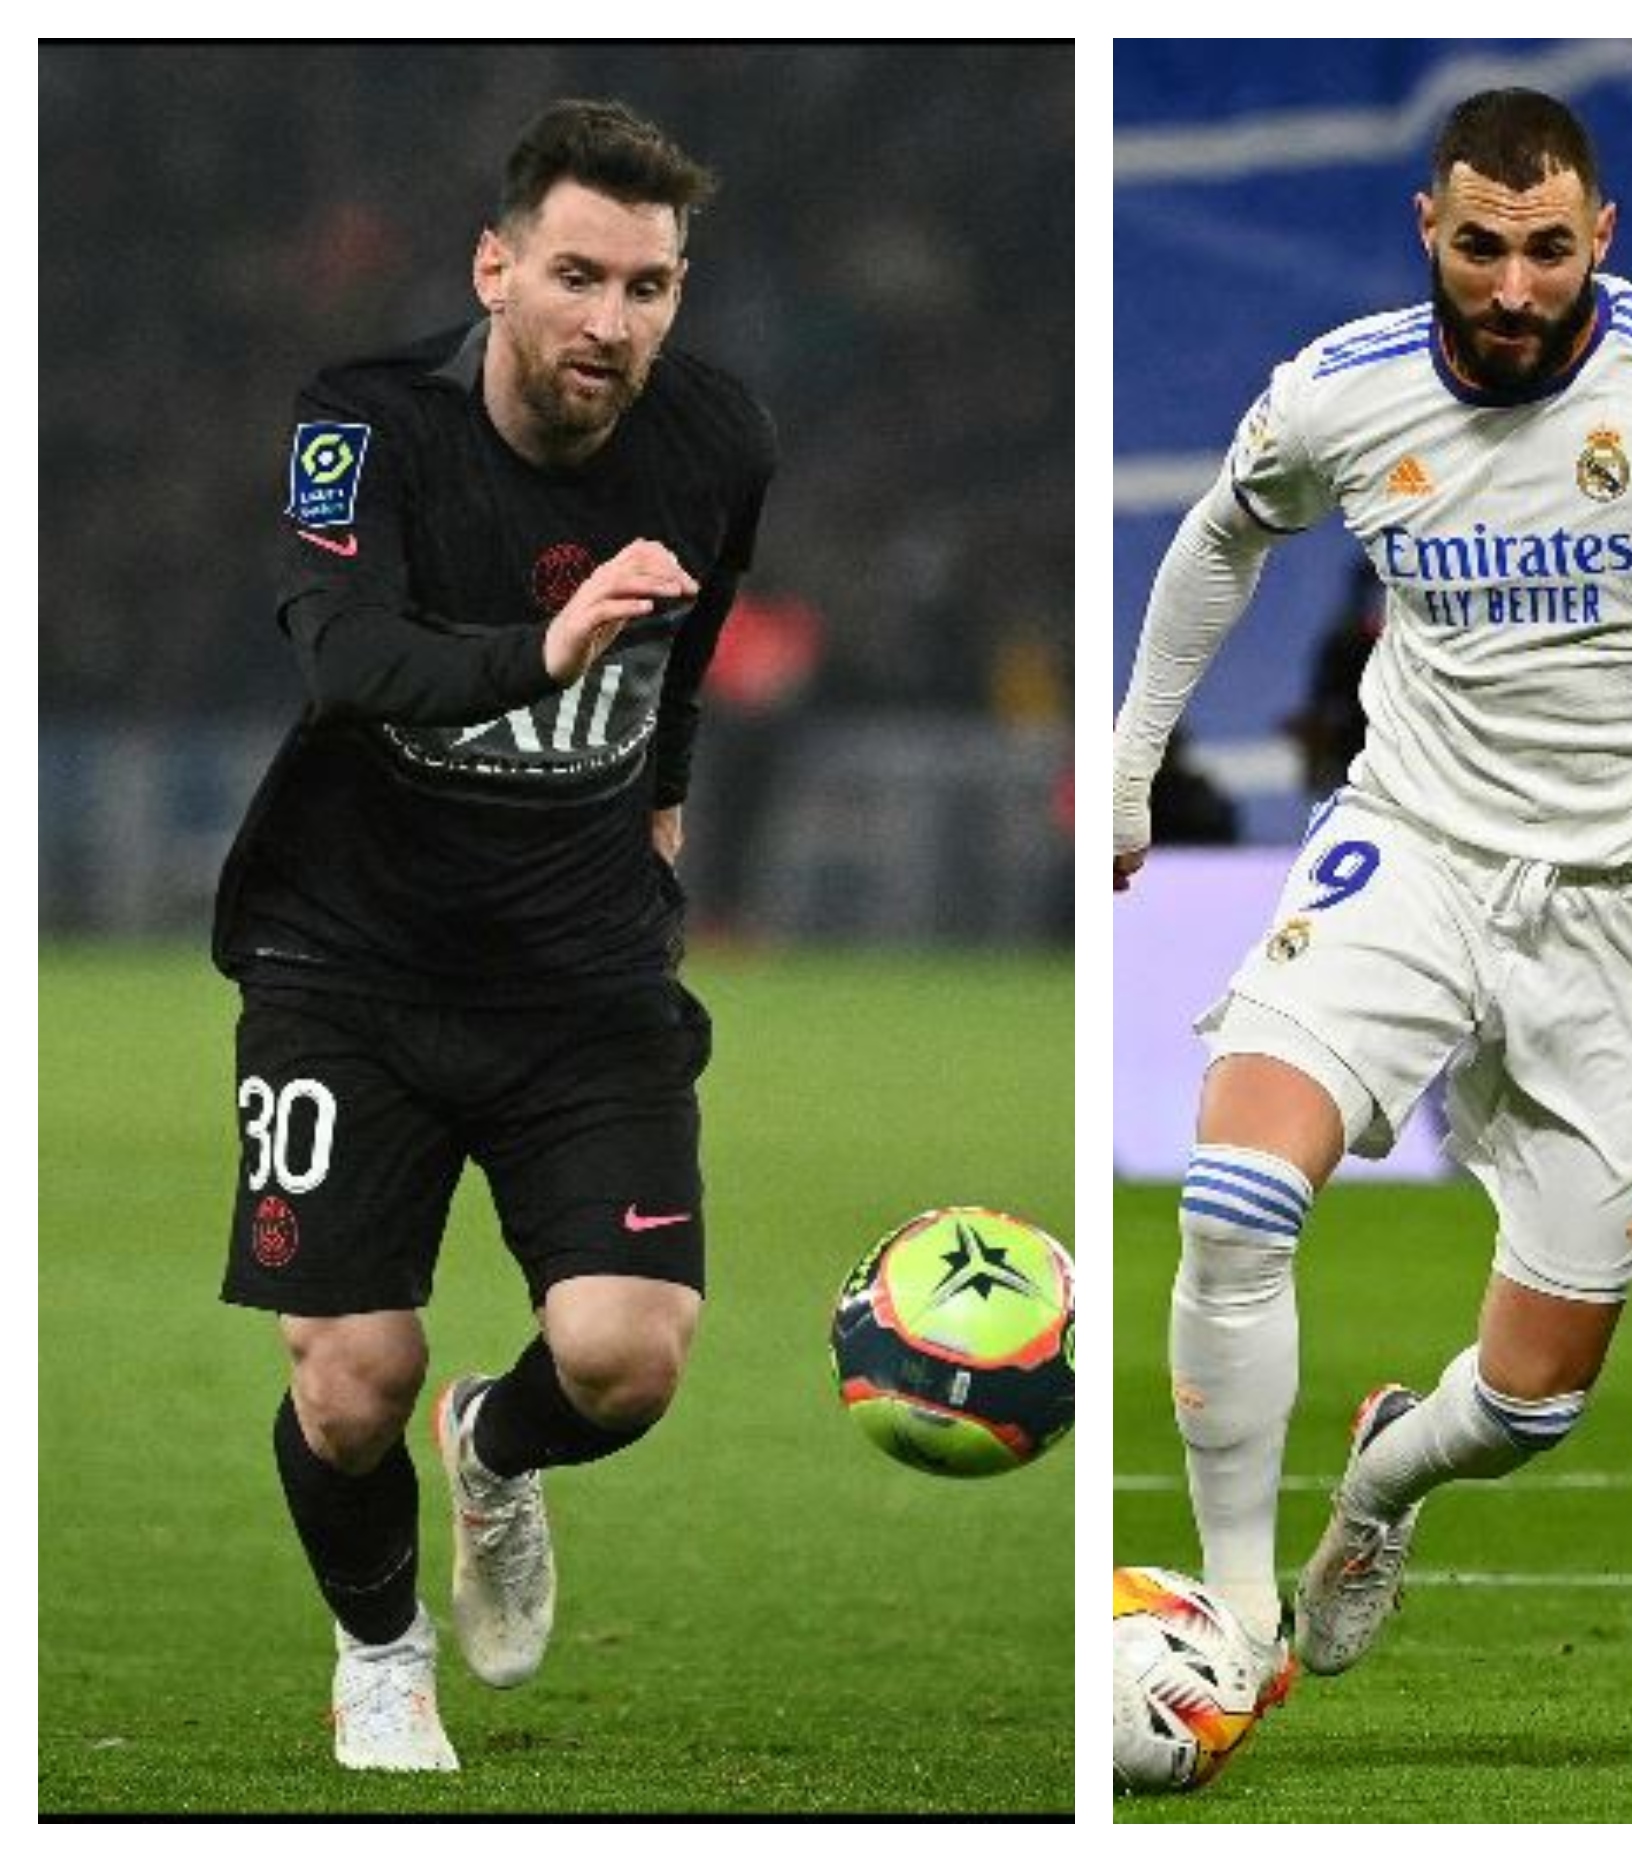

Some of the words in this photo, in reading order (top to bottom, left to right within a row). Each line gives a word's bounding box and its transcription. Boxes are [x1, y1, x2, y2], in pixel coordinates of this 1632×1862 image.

[1424, 589, 1471, 627] FLY
[1482, 583, 1600, 624] BETTER
[1301, 840, 1380, 911] 9
[238, 1074, 336, 1194] 30
